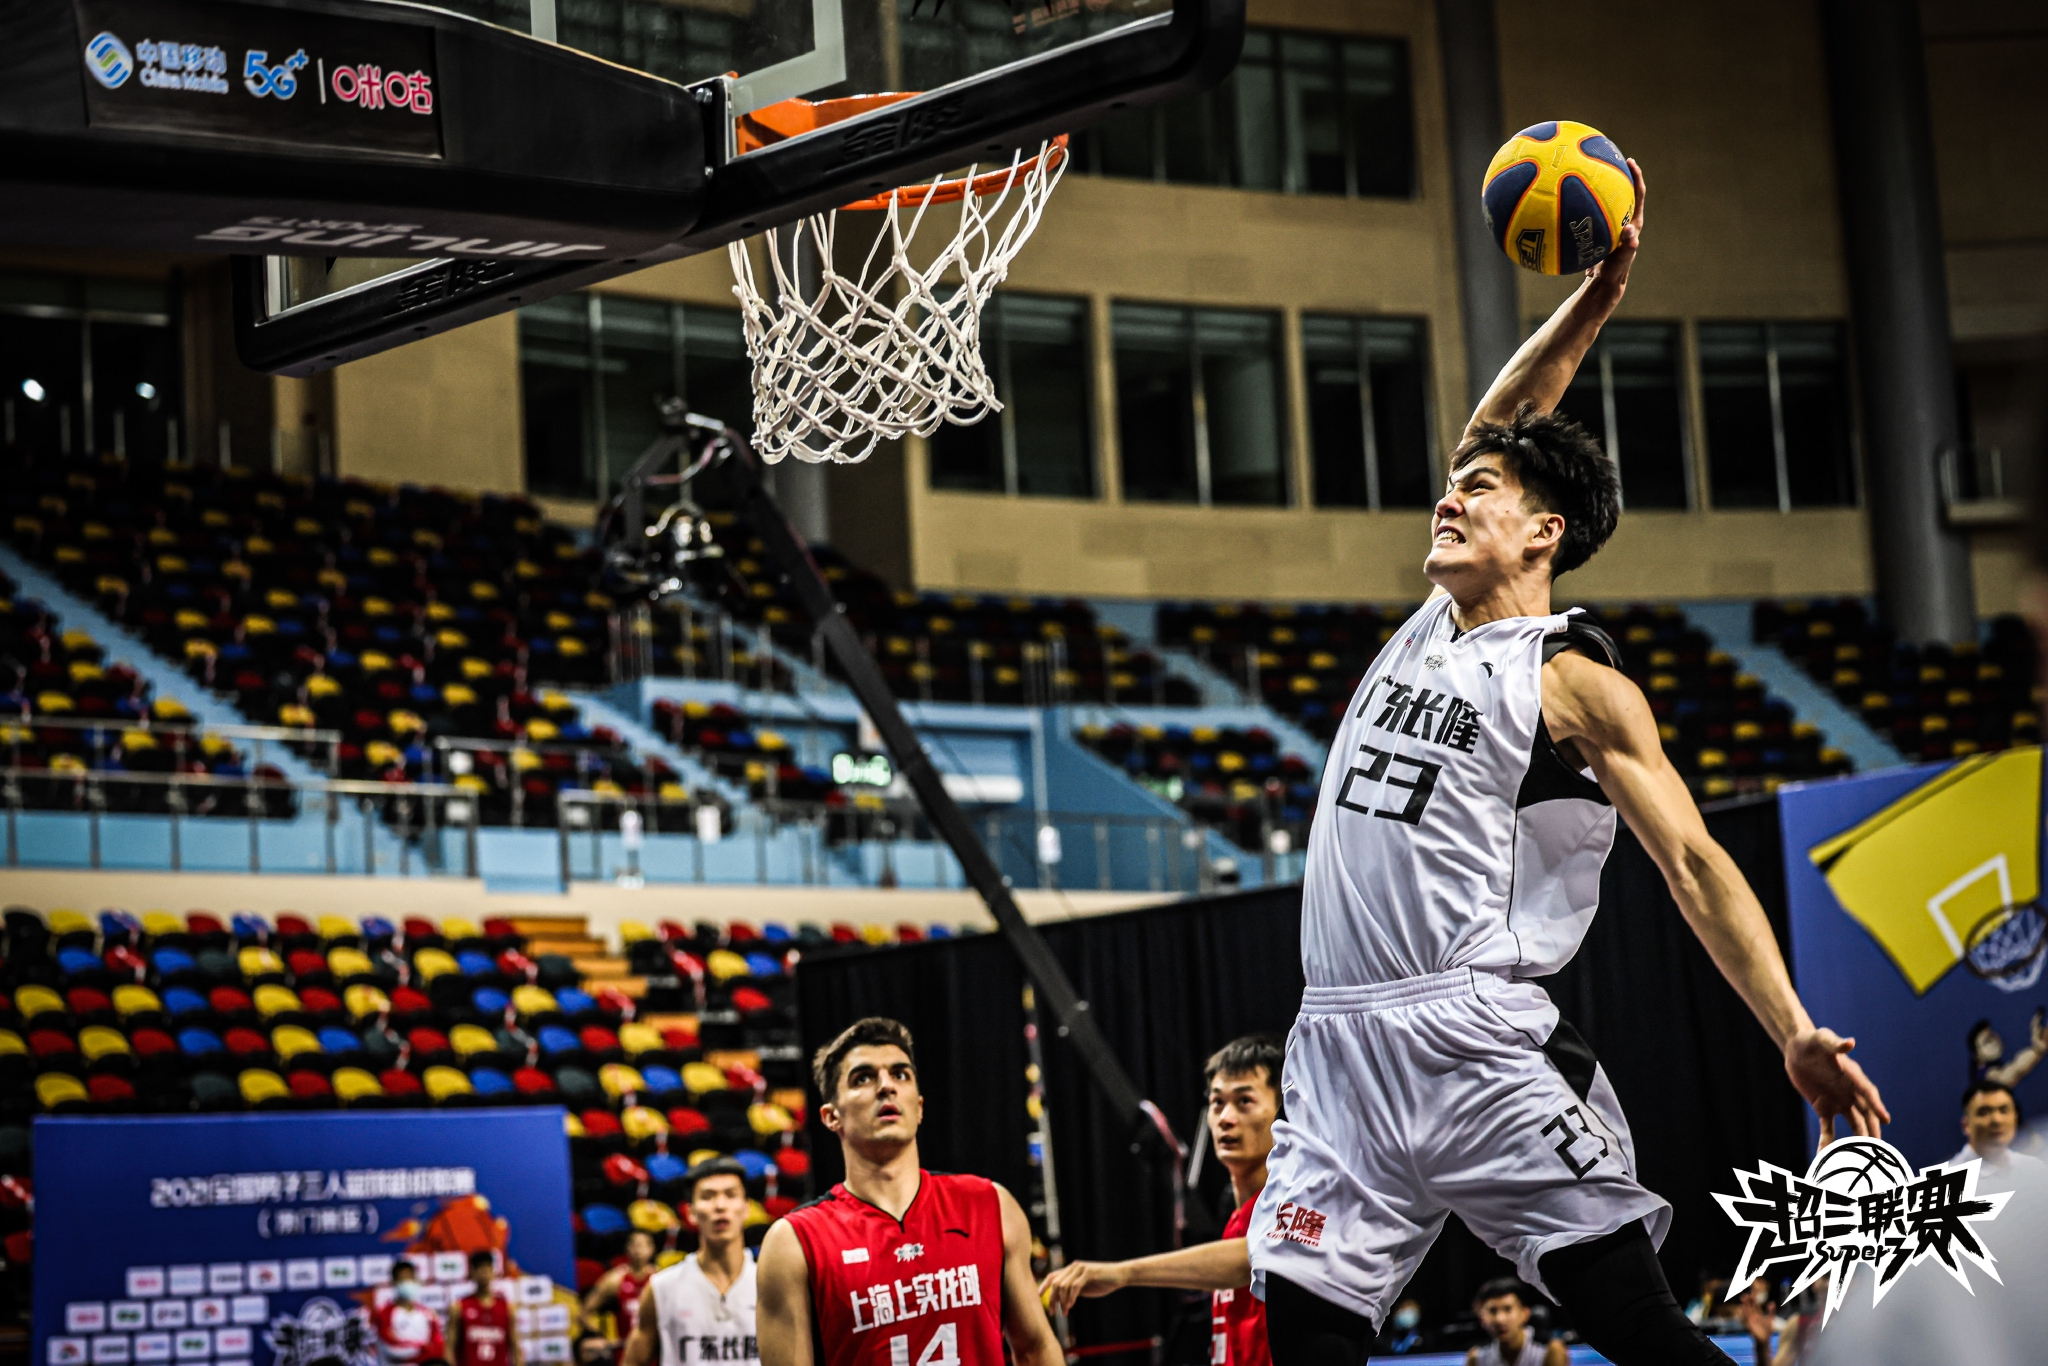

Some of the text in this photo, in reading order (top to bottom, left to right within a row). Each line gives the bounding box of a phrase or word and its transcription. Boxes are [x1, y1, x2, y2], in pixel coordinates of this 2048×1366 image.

[136, 39, 226, 74] 中国移动
[140, 68, 229, 94] China Mobile
[332, 64, 433, 115] 咪咕
[1356, 675, 1483, 754] 广东长隆
[1336, 744, 1442, 827] 23
[850, 1264, 982, 1334] 上海上实龙创
[890, 1322, 962, 1366] 14
